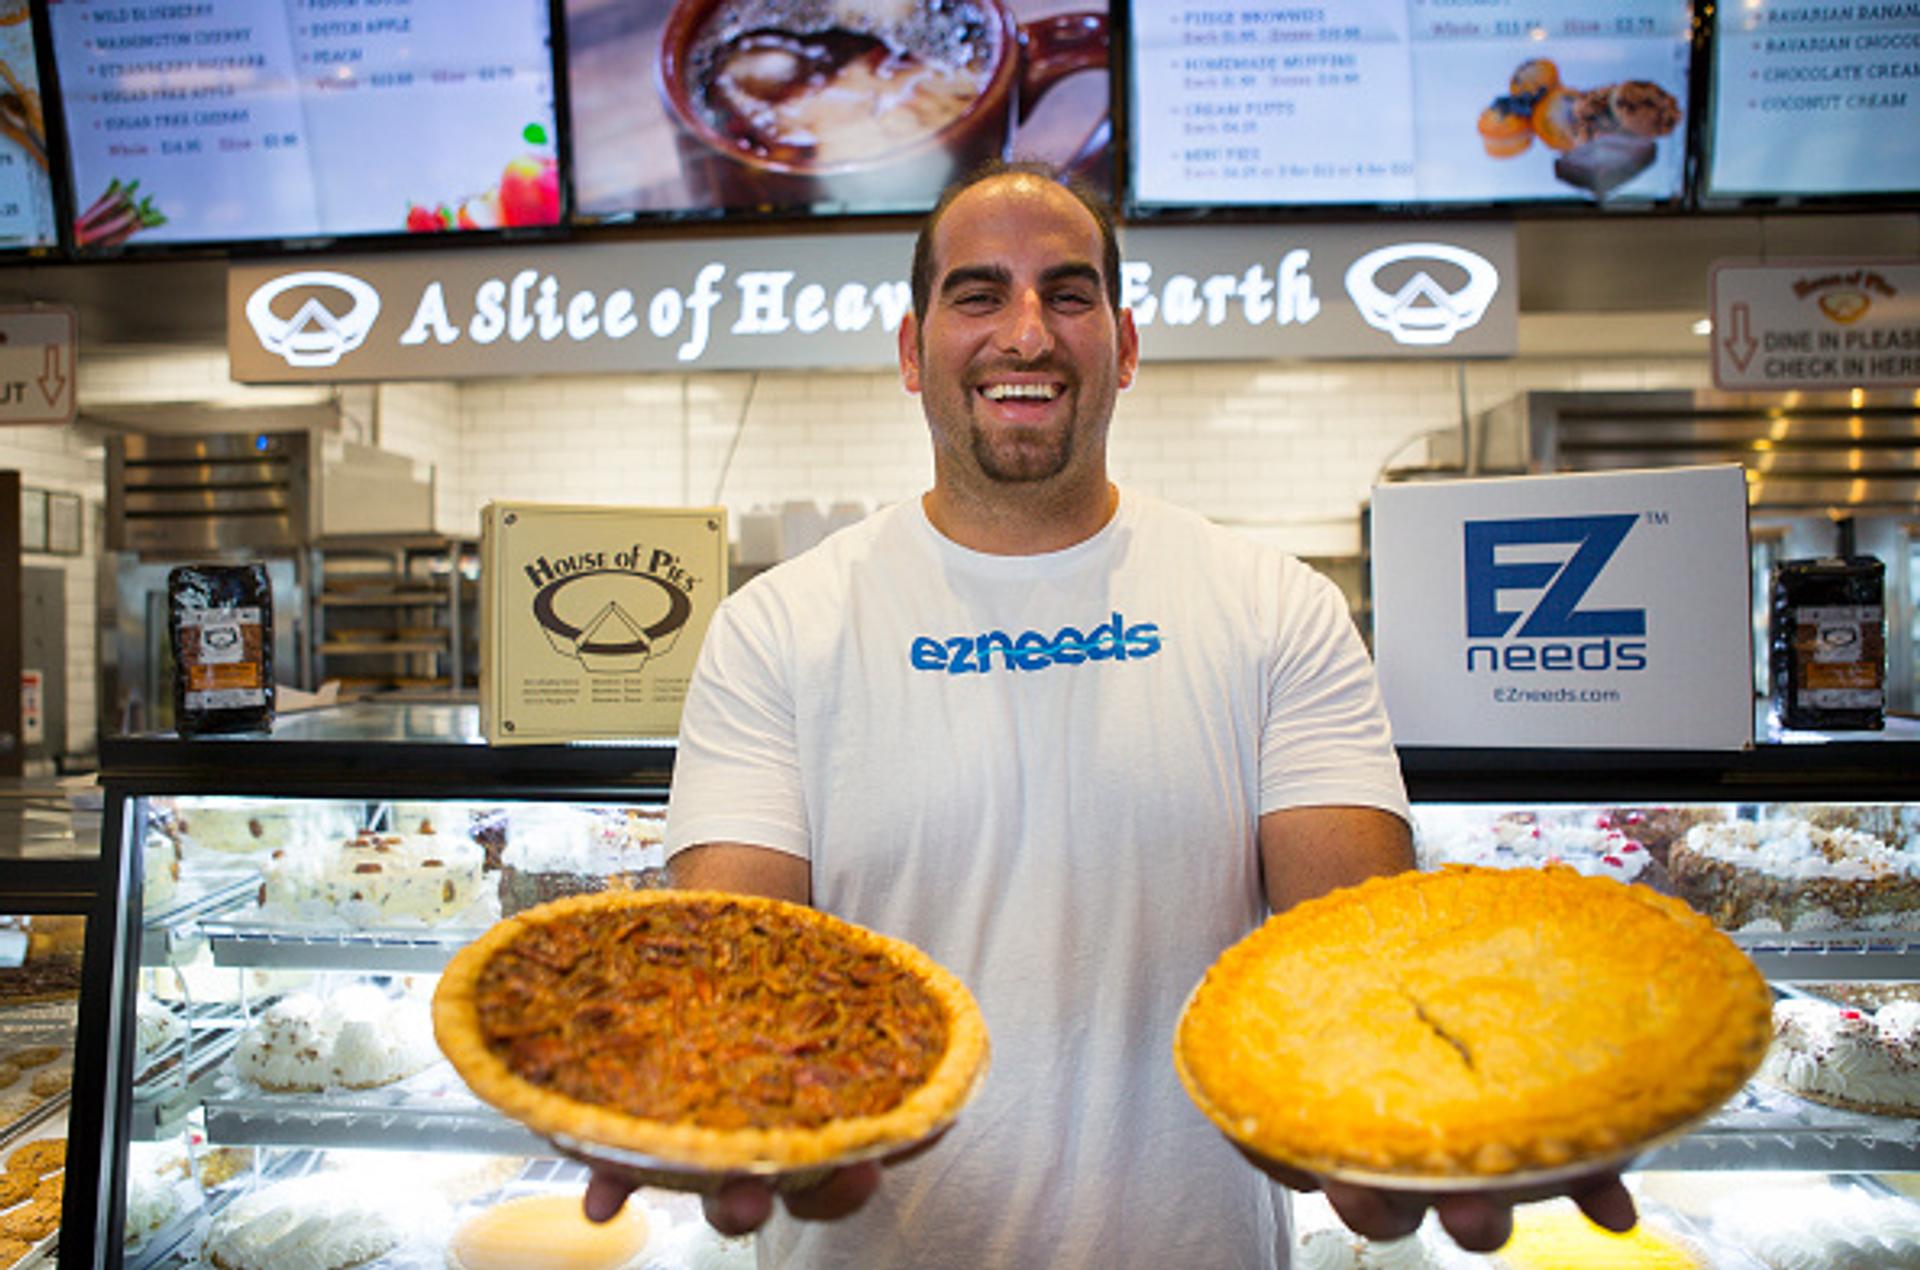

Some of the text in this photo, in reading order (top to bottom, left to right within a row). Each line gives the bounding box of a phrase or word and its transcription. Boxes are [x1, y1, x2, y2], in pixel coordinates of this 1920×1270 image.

[1765, 37, 1850, 53] BAVARIAN
[1762, 64, 1862, 81] CHOCOLATE
[1761, 91, 1908, 112] COCONUT CREAM
[400, 281, 460, 345] A
[468, 268, 640, 346] Slice
[648, 262, 726, 362] of
[1120, 249, 1321, 327] Earth
[1764, 330, 1811, 352] DINE
[1818, 329, 1839, 351] IN
[1763, 357, 1839, 379] CHECK
[1843, 356, 1864, 378] IN
[1464, 513, 1646, 638] EZ
[910, 611, 1162, 675] ezneeds
[1466, 637, 1647, 673] needs
[1493, 688, 1621, 703] EZneeds.com
